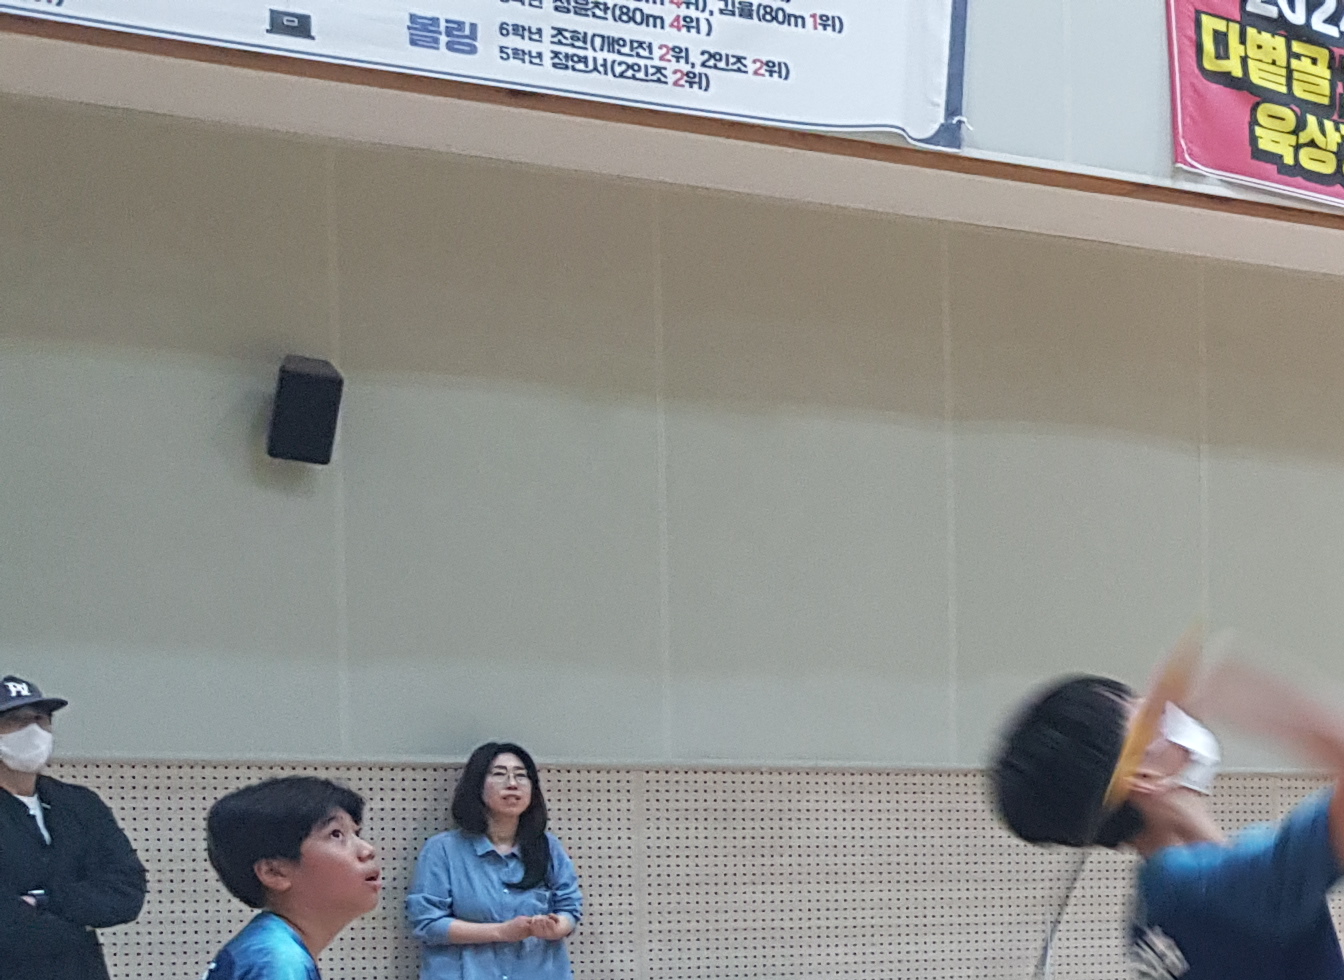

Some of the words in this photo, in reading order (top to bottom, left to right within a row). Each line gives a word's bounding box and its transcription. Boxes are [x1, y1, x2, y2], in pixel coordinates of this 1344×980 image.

[406, 13, 479, 55] 볼링
[810, 13, 844, 34] 1위)
[499, 22, 543, 43] 6학년
[550, 26, 654, 60] 조현(개인전
[658, 44, 696, 69] 2위,
[700, 50, 748, 74] 2인조
[752, 58, 790, 80] 2위)
[499, 45, 544, 67] 5학년
[550, 50, 669, 85] 정연서(2인조
[672, 69, 711, 92] 2위)
